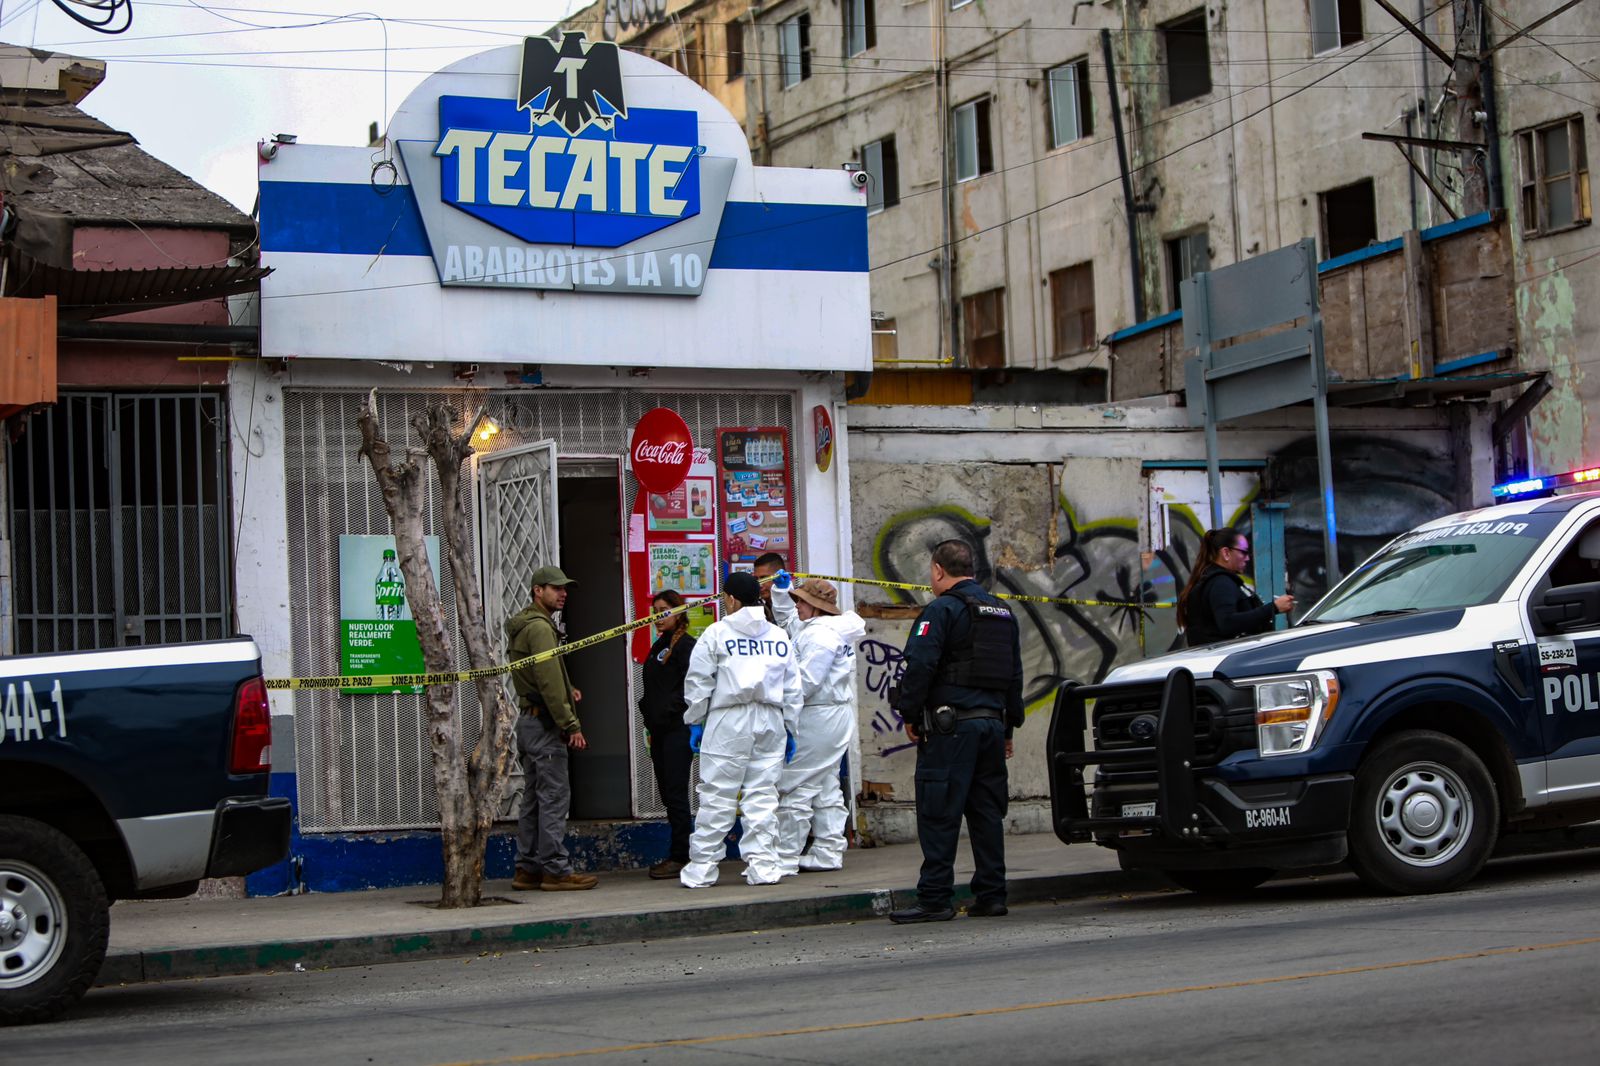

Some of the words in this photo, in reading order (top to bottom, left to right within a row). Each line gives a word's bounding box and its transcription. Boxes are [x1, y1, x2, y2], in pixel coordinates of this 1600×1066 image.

[553, 57, 588, 99] T
[435, 128, 694, 217] TECATE
[442, 245, 615, 287] ABARROTES
[626, 251, 661, 287] LA
[670, 252, 702, 288] 10
[634, 439, 689, 465] Coca-Cola
[376, 583, 404, 600] Sprite
[348, 623, 373, 631] NUEVO
[374, 623, 394, 631] LOOK
[348, 631, 392, 639] REALMENTE
[348, 639, 375, 647] VERDE.
[725, 638, 788, 658] PERITO
[1496, 642, 1519, 650] F-150
[1540, 648, 1575, 661] SS-238-22
[299, 677, 341, 689] PROHIBIDO
[341, 678, 351, 686] EL
[352, 676, 373, 687] PASO
[391, 675, 413, 686] LINEA
[415, 675, 426, 685] DE
[427, 673, 460, 684] POLICIA
[1245, 806, 1291, 828] BC-960-A1
